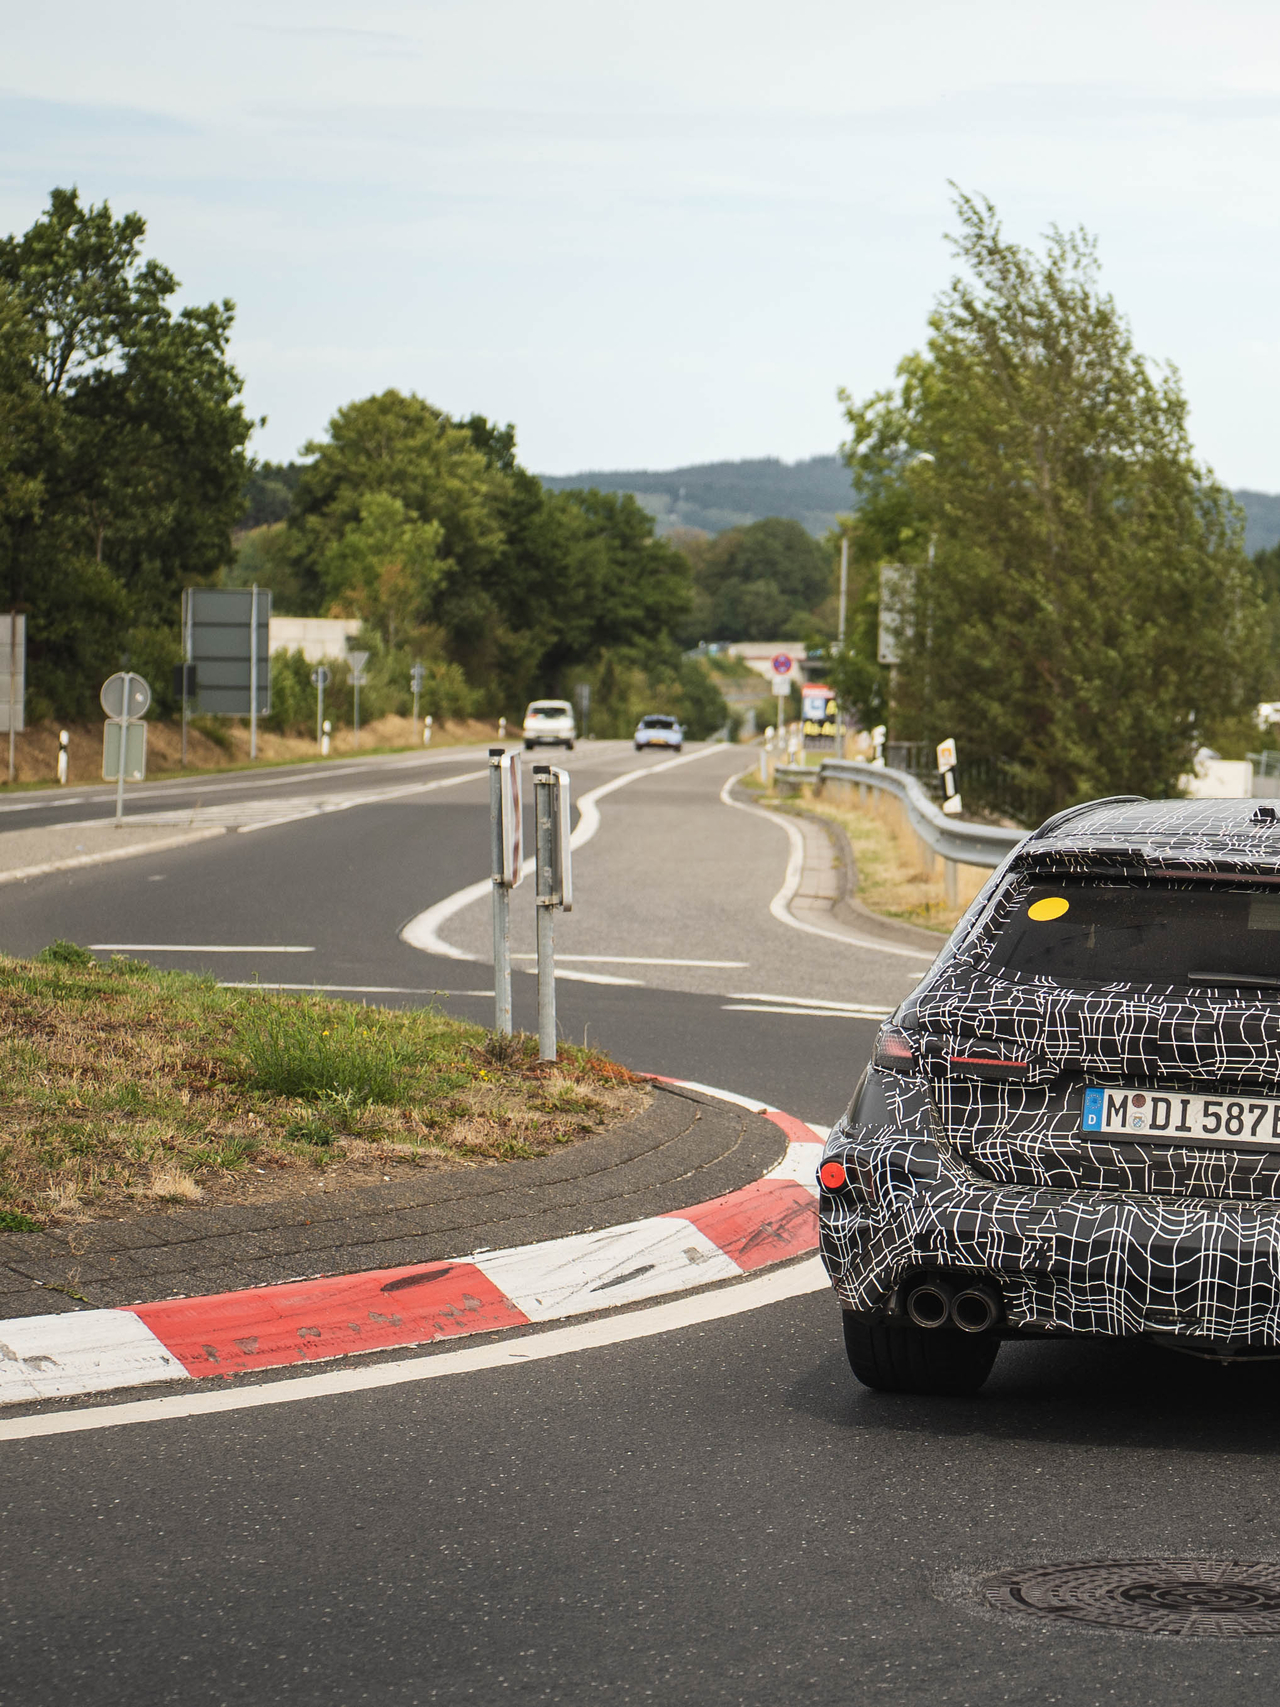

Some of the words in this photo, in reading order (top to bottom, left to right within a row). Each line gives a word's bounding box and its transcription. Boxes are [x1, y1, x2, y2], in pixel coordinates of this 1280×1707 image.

[1087, 1114, 1096, 1125] D
[1105, 1094, 1129, 1128] M
[1150, 1096, 1192, 1132] DI
